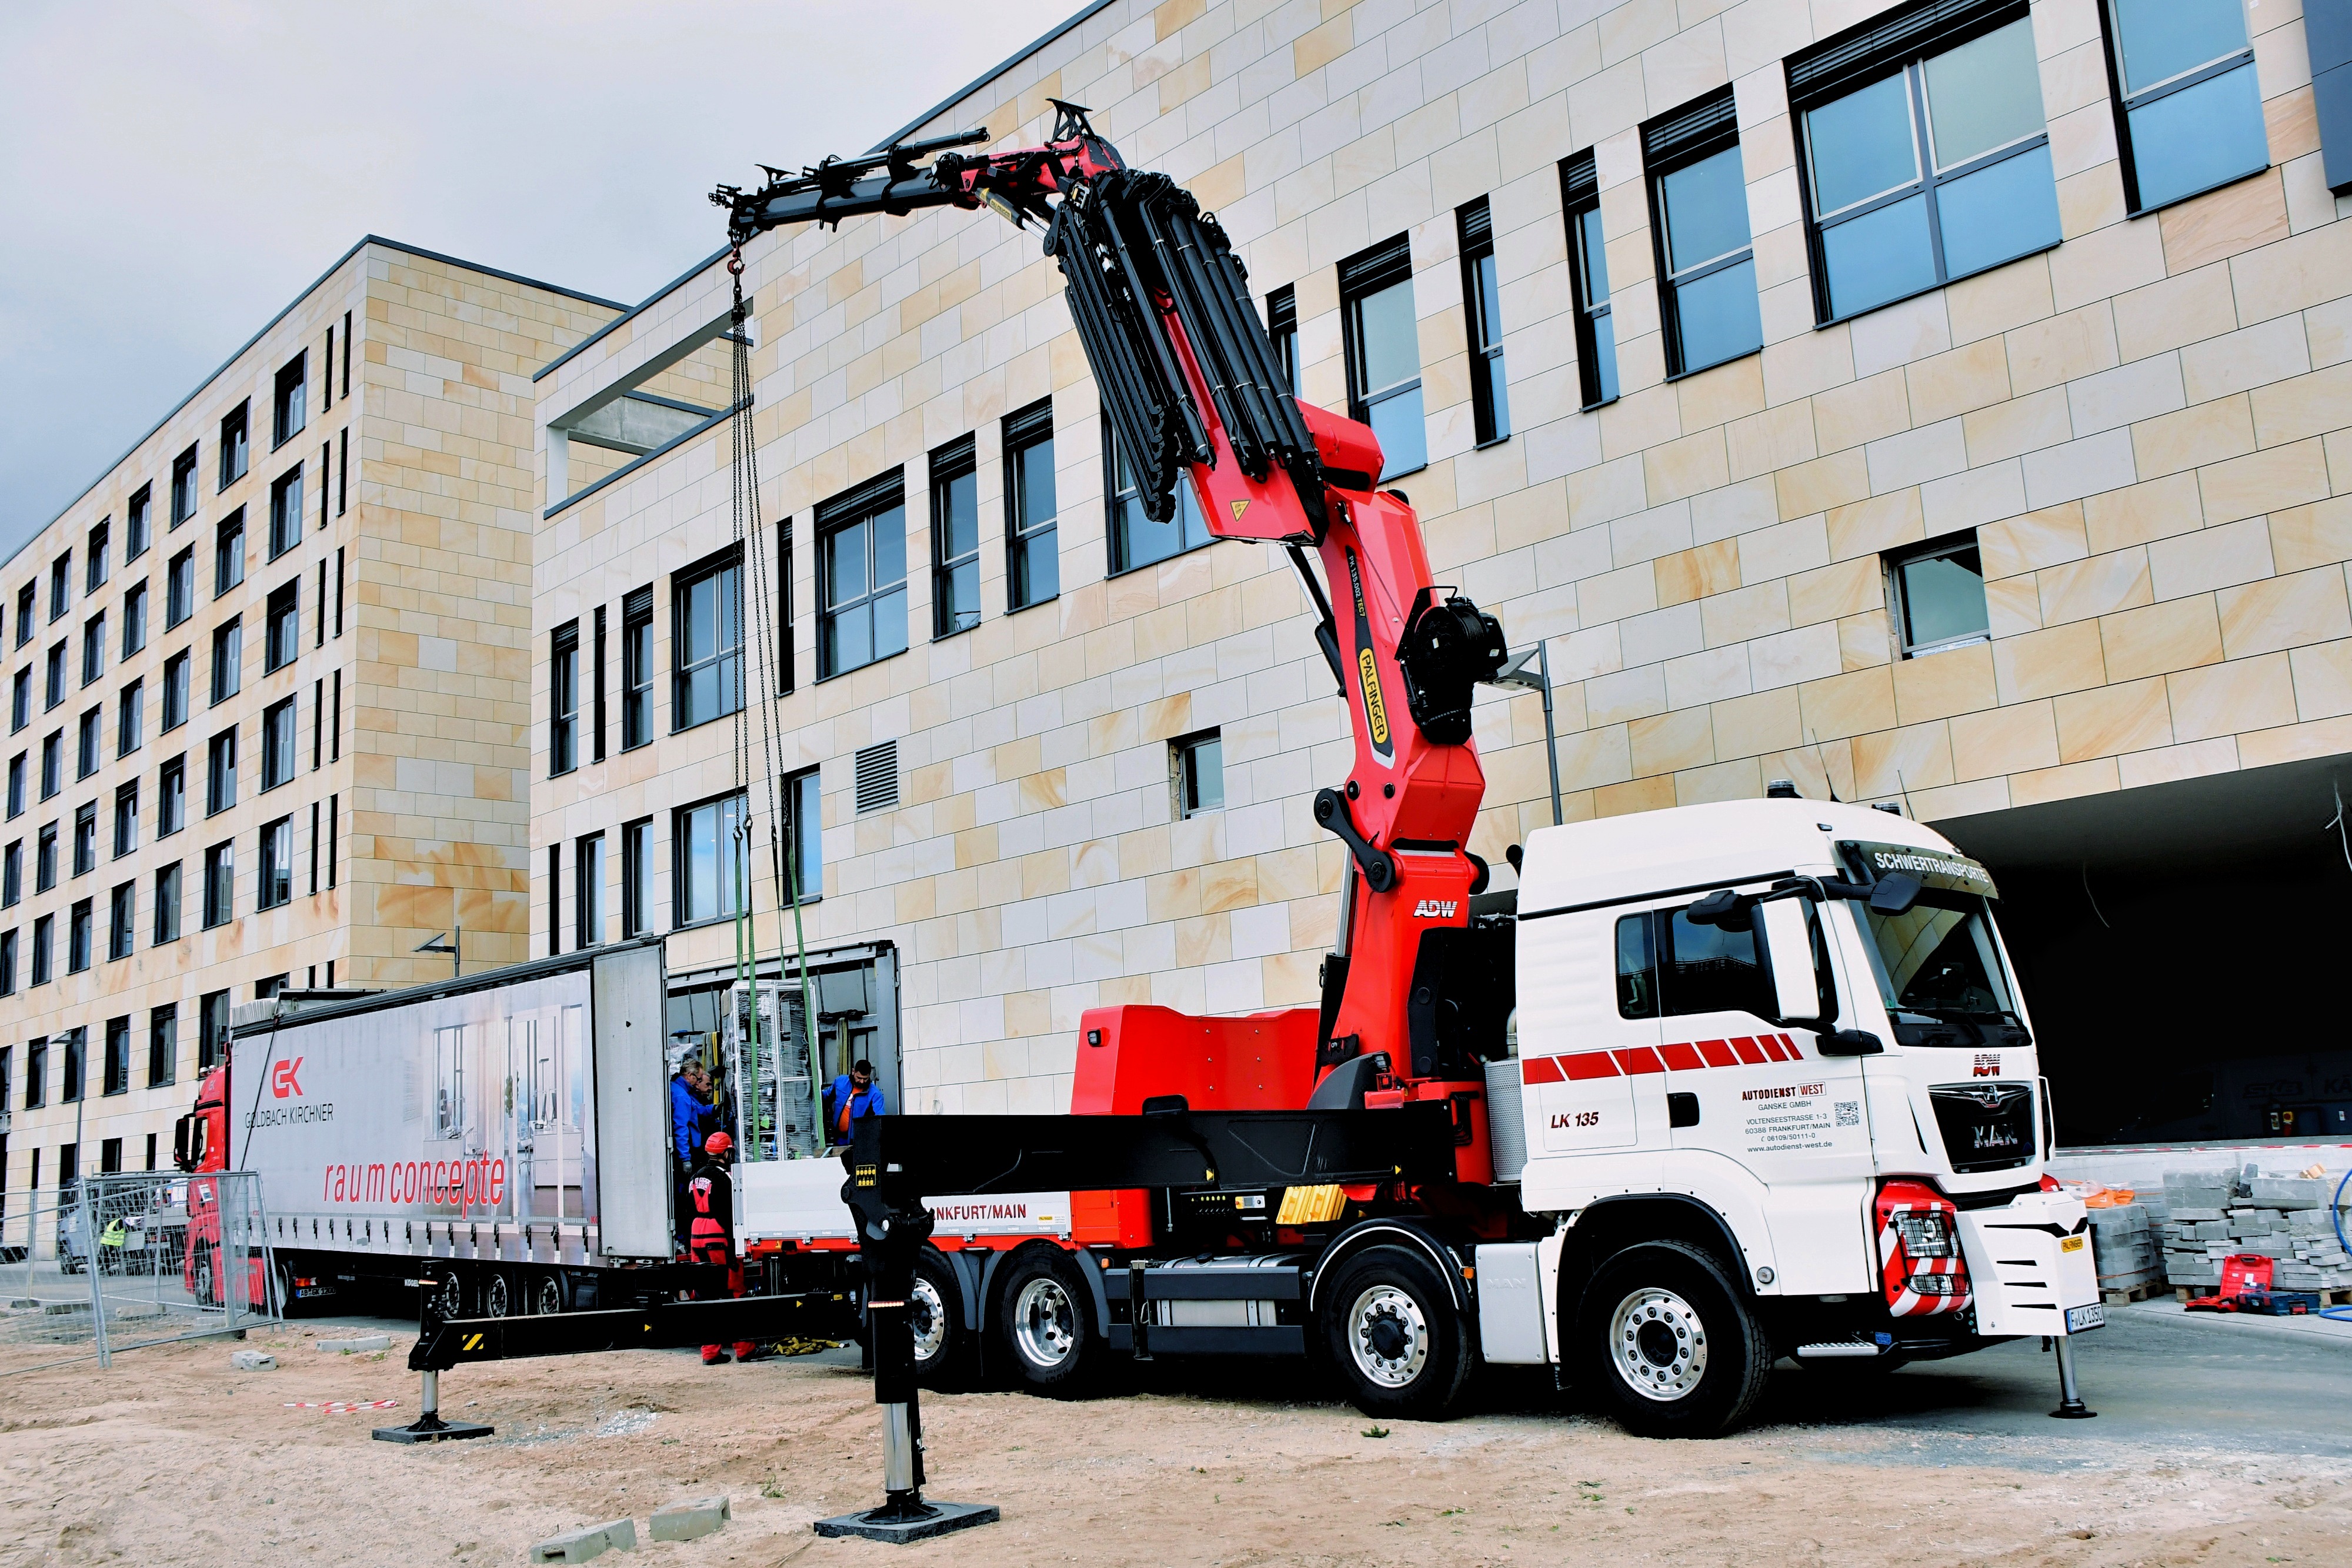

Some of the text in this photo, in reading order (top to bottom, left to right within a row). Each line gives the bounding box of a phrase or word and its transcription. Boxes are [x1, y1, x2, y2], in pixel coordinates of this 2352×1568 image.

[1349, 555, 1366, 617] PK 135.002 TEC7
[1362, 653, 1385, 739] PALFINGER
[1874, 852, 1990, 883] SCHWERTRANSPORTE
[1413, 900, 1458, 918] ADW
[1973, 1054, 2000, 1077] ADW
[1742, 1083, 1824, 1101] AUTODIENST WEST
[1758, 1100, 1811, 1111] GANSKE GMBH
[245, 1103, 333, 1129] GOLDBACH KIRCHNER
[1551, 1111, 1599, 1129] LK 135
[1746, 1114, 1814, 1125] VOLTENSEESTRASSE
[1745, 1122, 1831, 1135] 60388 FRANKFURT/MAIN
[1767, 1132, 1816, 1142] 06109/50111-0
[1971, 1123, 2018, 1149] MAN
[1747, 1140, 1833, 1153] www.autodienst-west.de
[324, 1149, 505, 1220] raumconcepte
[932, 1203, 1027, 1221] NKFURT/MAIN
[1486, 1278, 1527, 1289] MAN
[2071, 1306, 2103, 1327] F LK 1350
